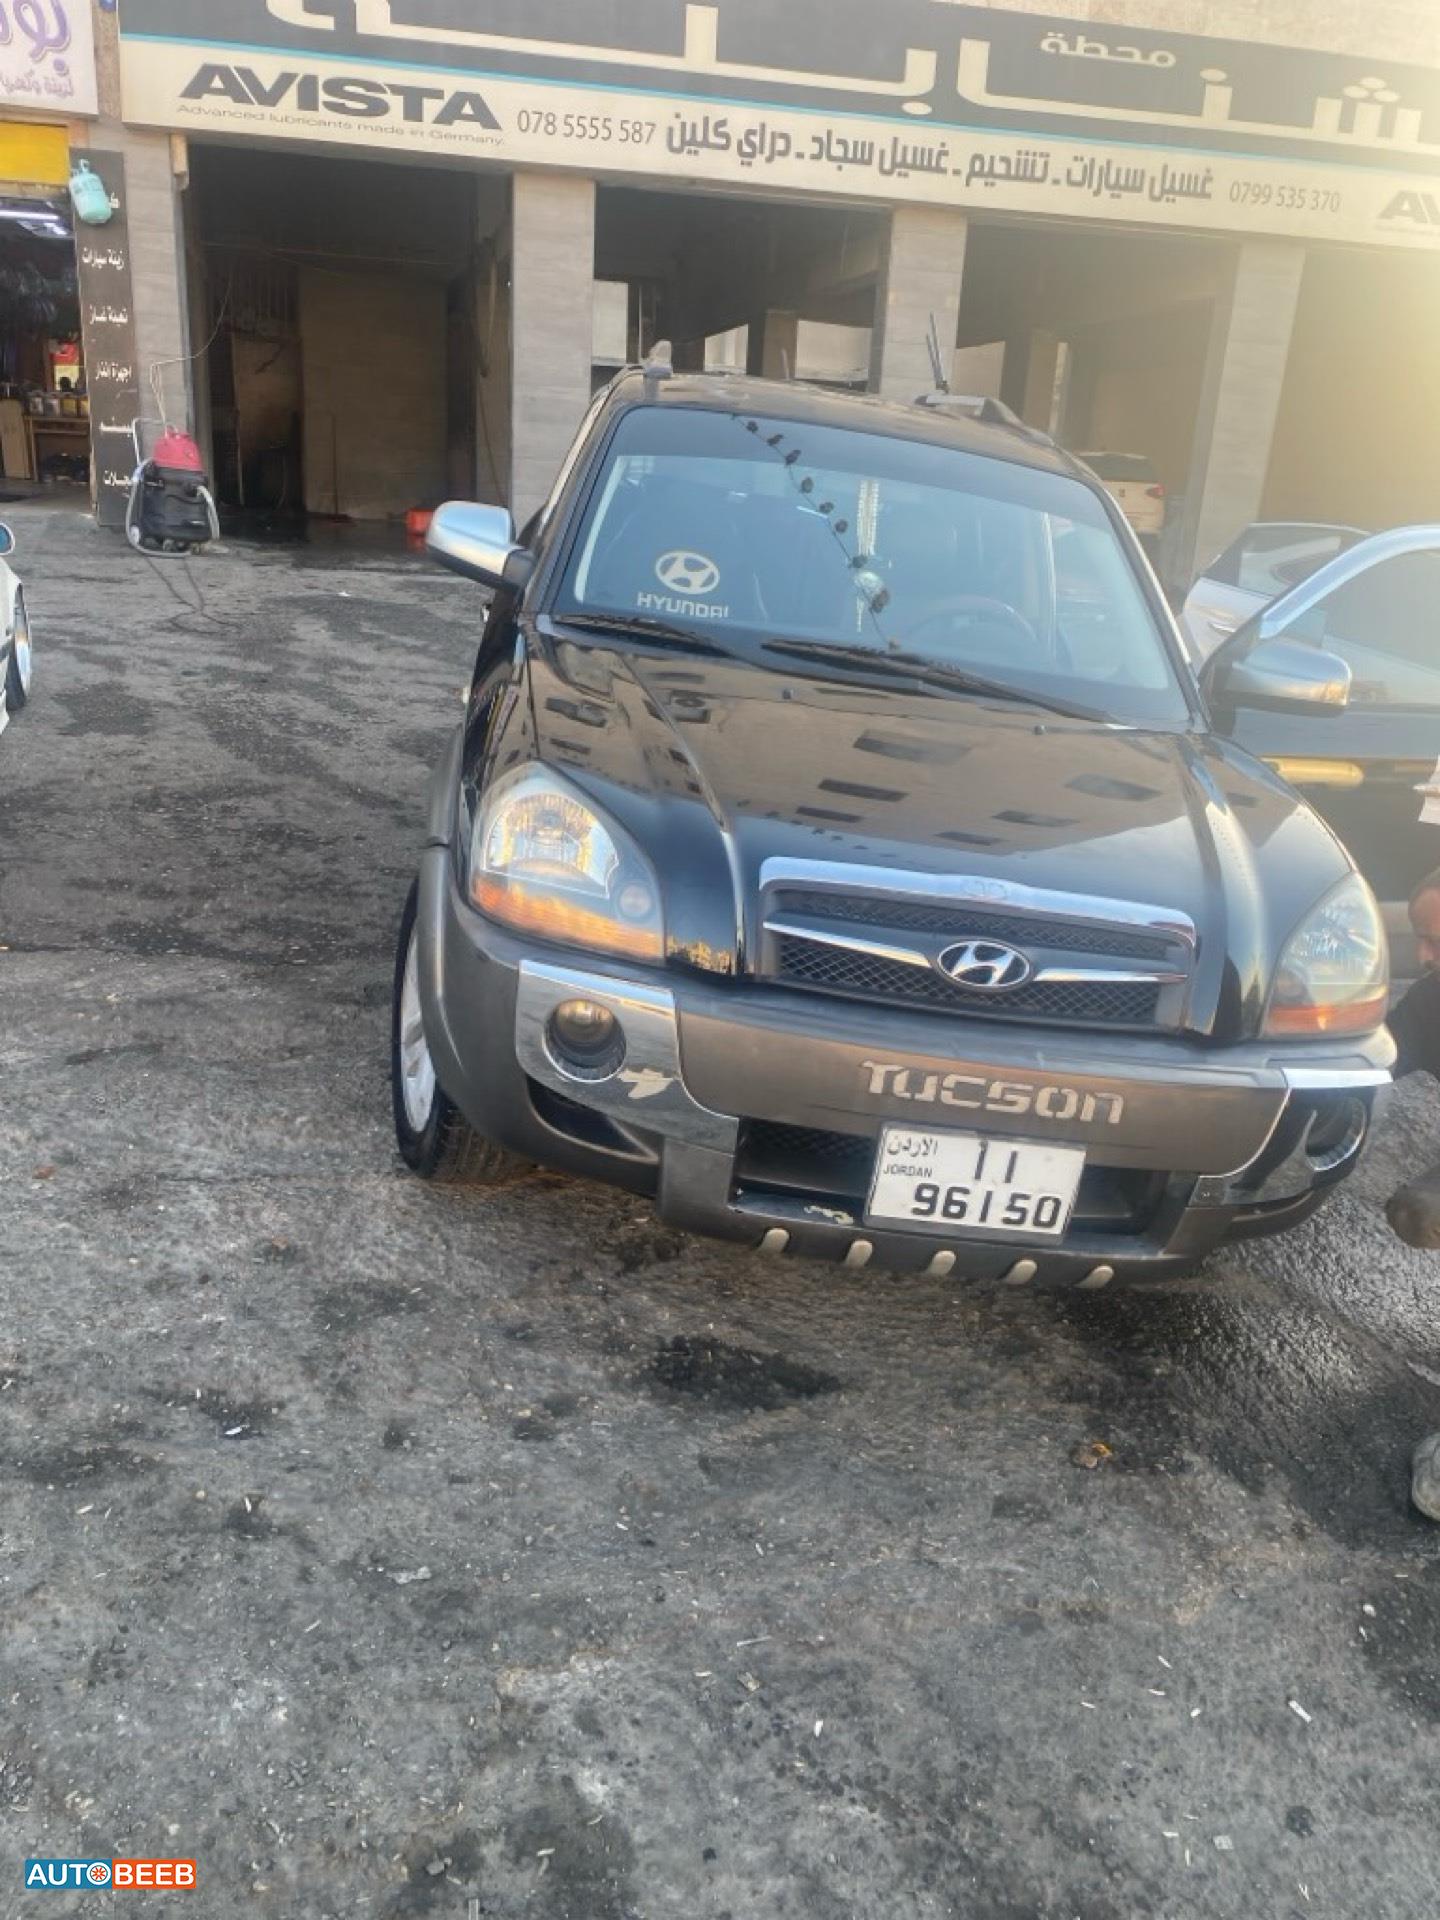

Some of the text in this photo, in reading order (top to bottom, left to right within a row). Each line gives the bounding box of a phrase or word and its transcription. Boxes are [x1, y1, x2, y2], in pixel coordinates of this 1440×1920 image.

[1040, 31, 1176, 69] محطة
[179, 63, 503, 131] AVISTA
[177, 103, 265, 121] Advanced
[269, 113, 353, 131] lubricants
[357, 123, 405, 137] made
[410, 128, 425, 138] in
[517, 110, 656, 145] 078 5555 587
[666, 112, 731, 157] كلين
[736, 121, 792, 166] دراي
[809, 129, 875, 171] سجاد
[878, 136, 949, 178] غسيل
[965, 149, 1050, 187] تشحيم
[1066, 155, 1145, 199] سيارات
[1149, 163, 1213, 204] غسيل
[1229, 180, 1341, 213] 0799 535 370
[637, 591, 729, 618] HYUNDAI
[863, 1060, 1124, 1124] TUCSON
[886, 1135, 938, 1156] الاردن
[974, 1140, 1018, 1184] 11
[883, 1163, 933, 1179] JORDAN
[911, 1183, 1062, 1228] 96150
